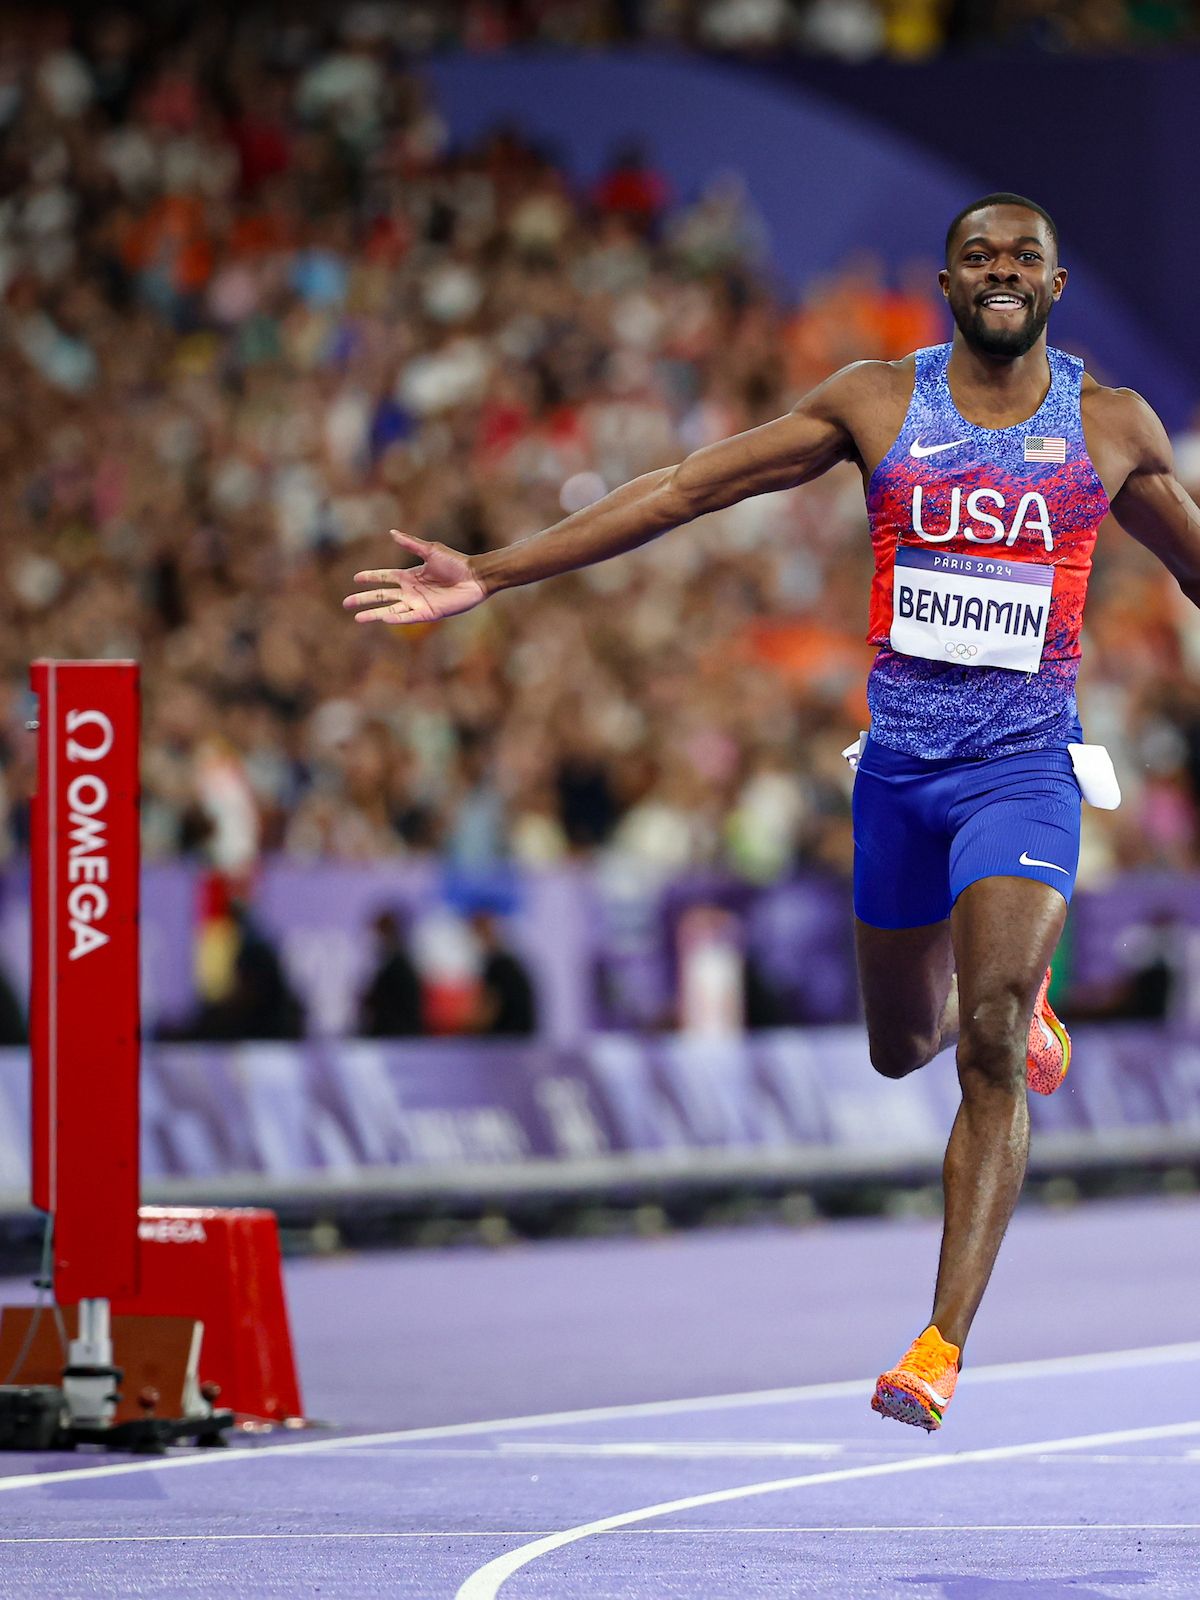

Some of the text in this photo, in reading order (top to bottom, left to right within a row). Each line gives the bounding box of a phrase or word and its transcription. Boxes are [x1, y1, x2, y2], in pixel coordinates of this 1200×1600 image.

[912, 485, 1054, 552] USA
[934, 556, 1012, 576] PARIS 2024
[899, 585, 1044, 637] BENJAMIN
[67, 774, 110, 961] OMEGA
